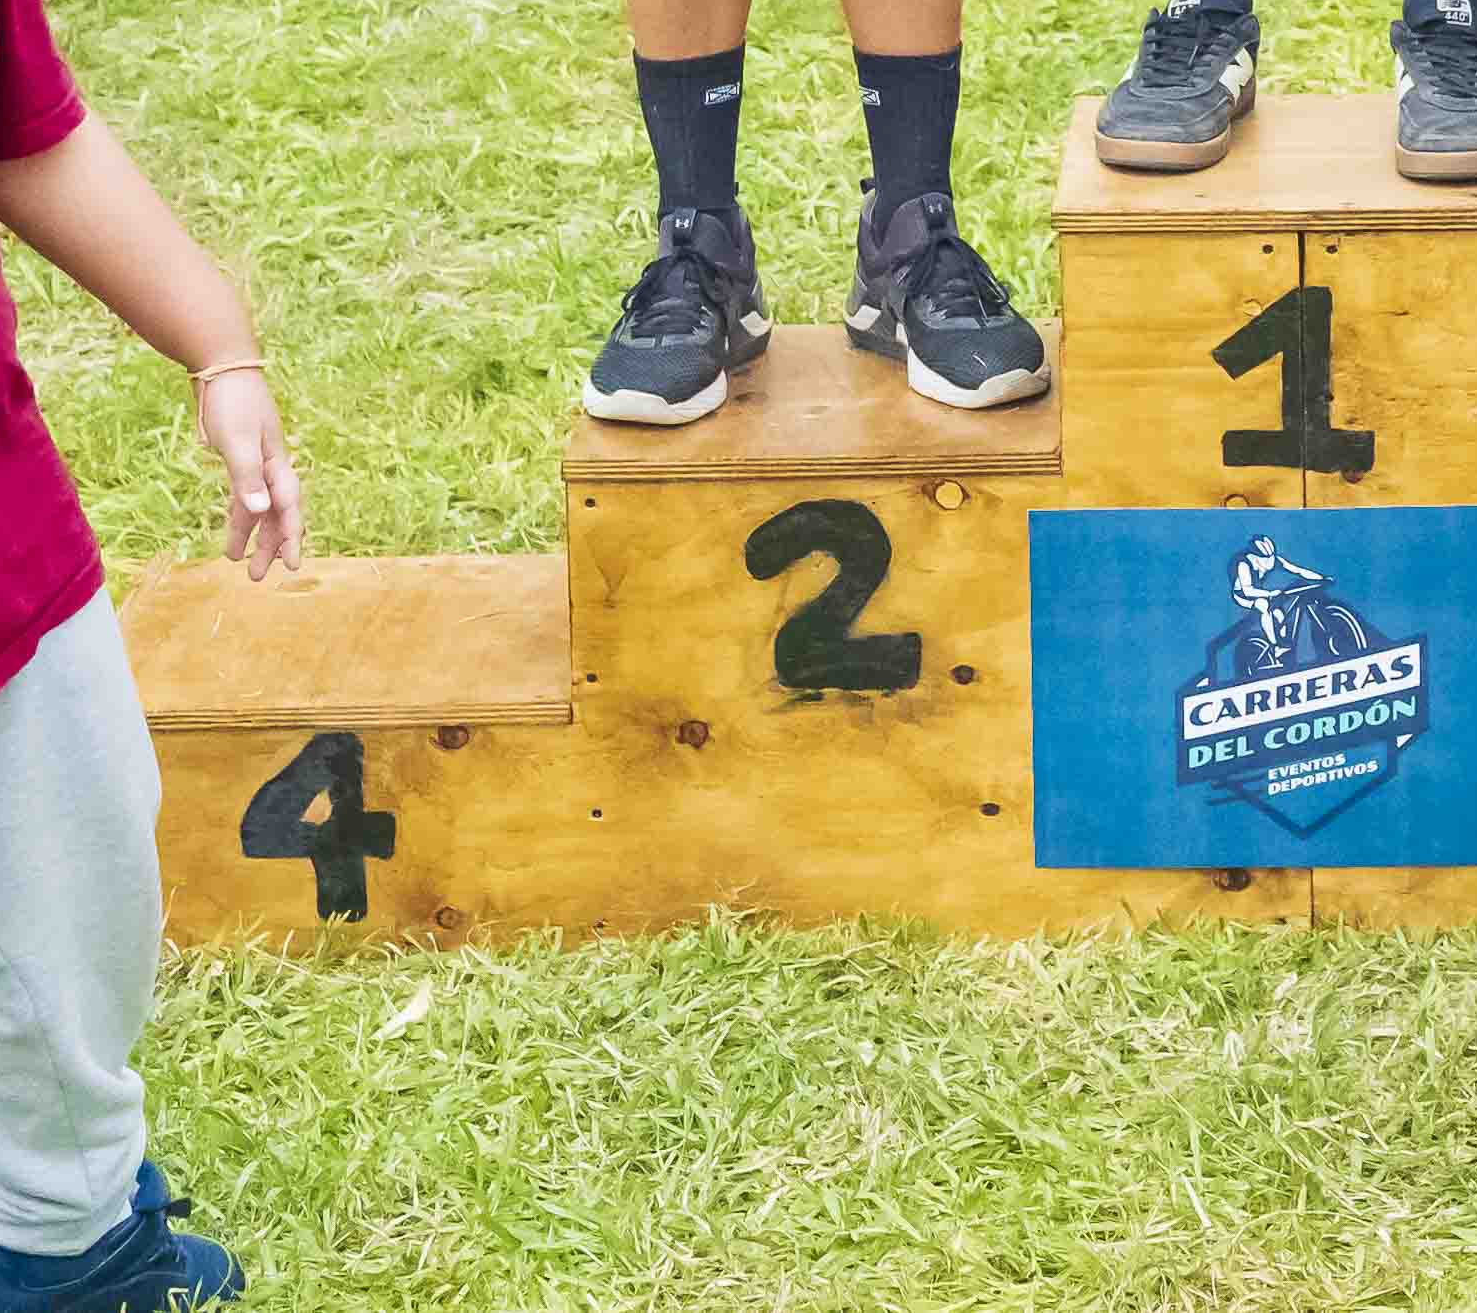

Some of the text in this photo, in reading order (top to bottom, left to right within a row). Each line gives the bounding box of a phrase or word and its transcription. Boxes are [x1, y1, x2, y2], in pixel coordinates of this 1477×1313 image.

[1210, 285, 1375, 473] 1
[744, 498, 922, 691] 2
[1189, 655, 1414, 726] CARRERAS
[1188, 695, 1416, 768] DEL CORDÓN
[1268, 753, 1347, 780] EVENTOS
[1267, 761, 1380, 796] DEPORTIVOS
[239, 730, 397, 923] 4
